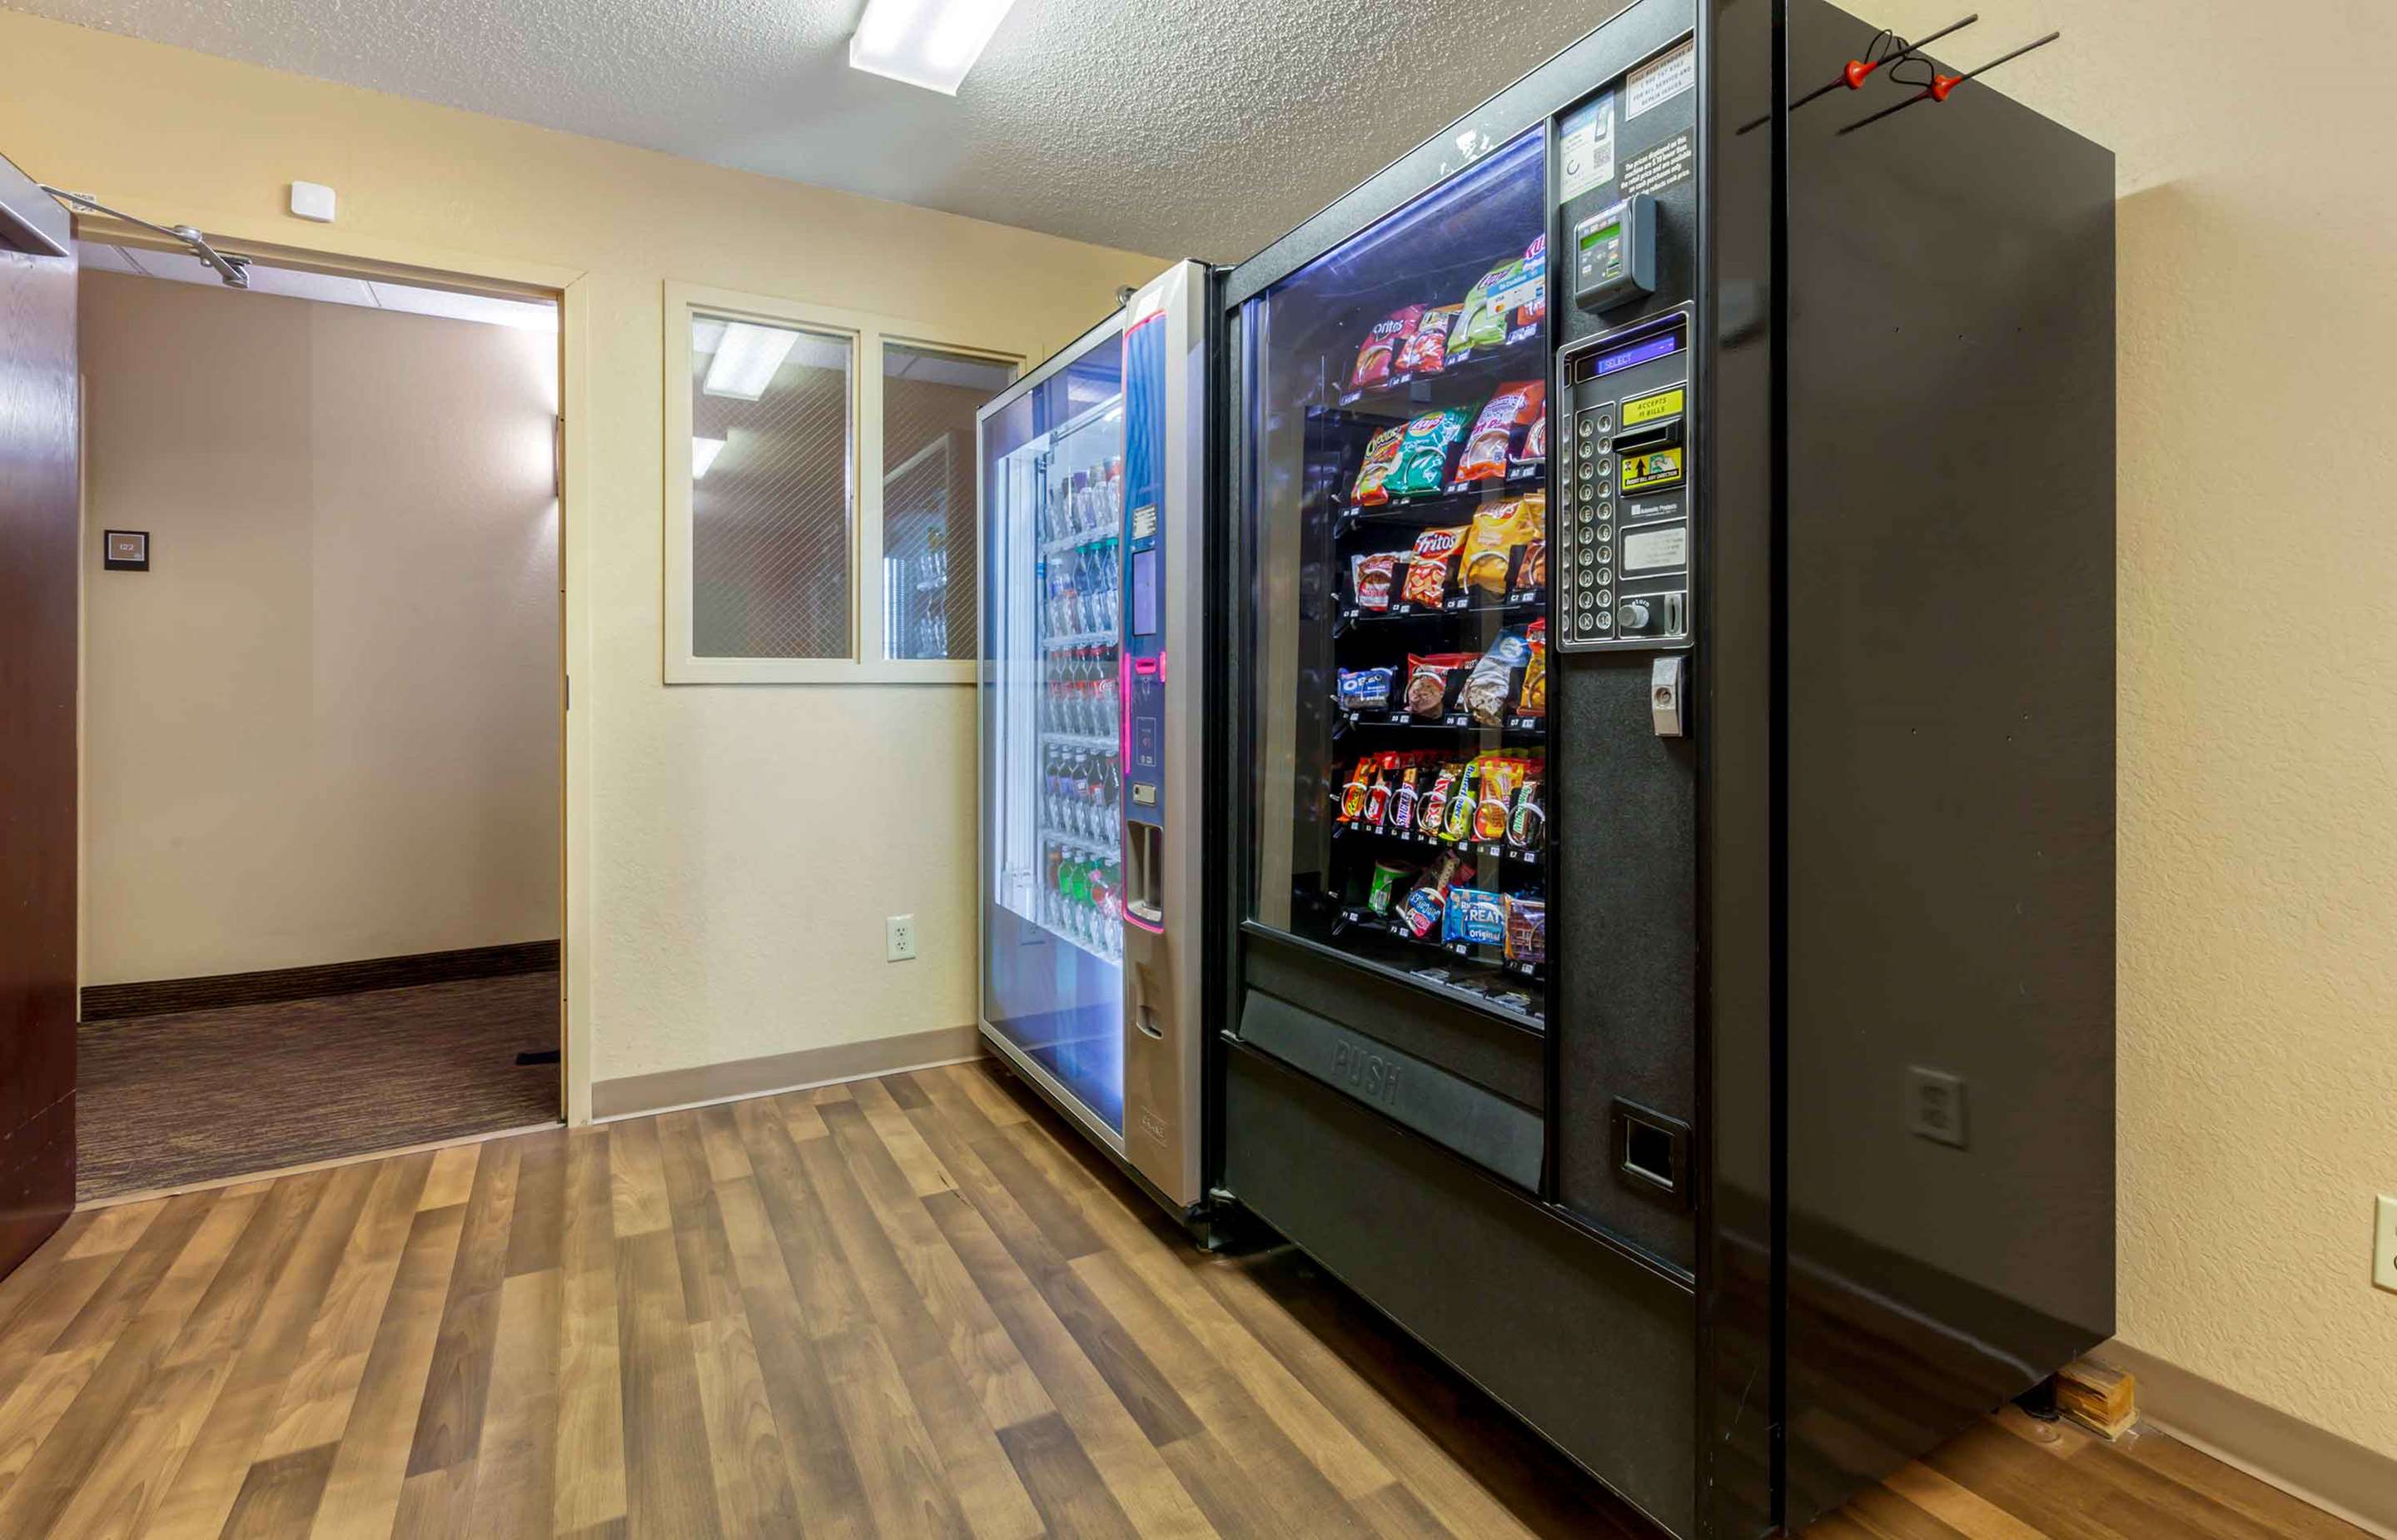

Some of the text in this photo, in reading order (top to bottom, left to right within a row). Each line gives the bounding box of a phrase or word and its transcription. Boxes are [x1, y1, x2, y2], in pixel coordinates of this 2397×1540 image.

[1372, 320, 1405, 334] oritos
[1604, 352, 1632, 370] SELECT
[1638, 397, 1667, 410] ACCEPTS
[1646, 406, 1665, 416] BILLS
[1417, 533, 1456, 554] Fritos
[1334, 1038, 1400, 1105] PUSH
